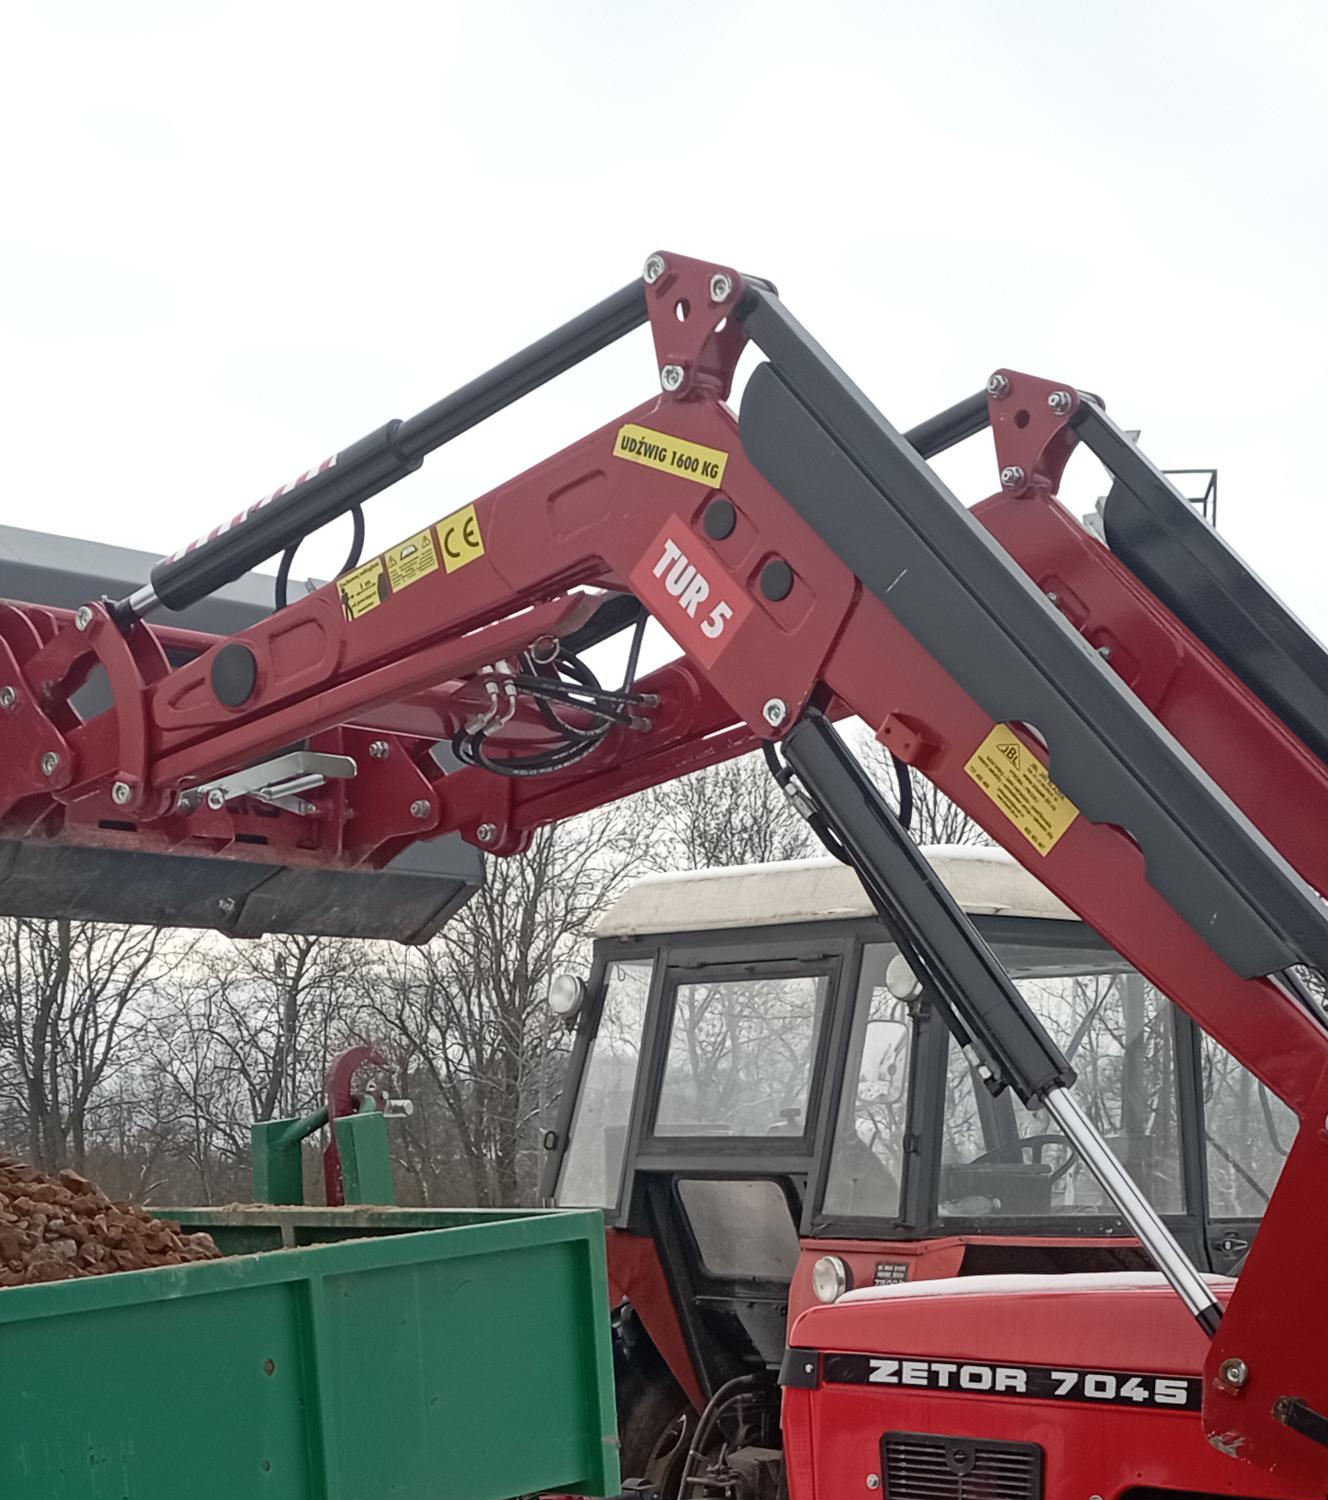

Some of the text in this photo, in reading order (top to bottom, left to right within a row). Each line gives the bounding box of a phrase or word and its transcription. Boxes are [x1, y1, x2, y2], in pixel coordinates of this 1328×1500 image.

[670, 450, 700, 473] 1600
[701, 460, 720, 479] KG
[443, 516, 480, 559] CE
[652, 538, 733, 638] TUR 5
[868, 1359, 1189, 1405] ZETOR 7045
